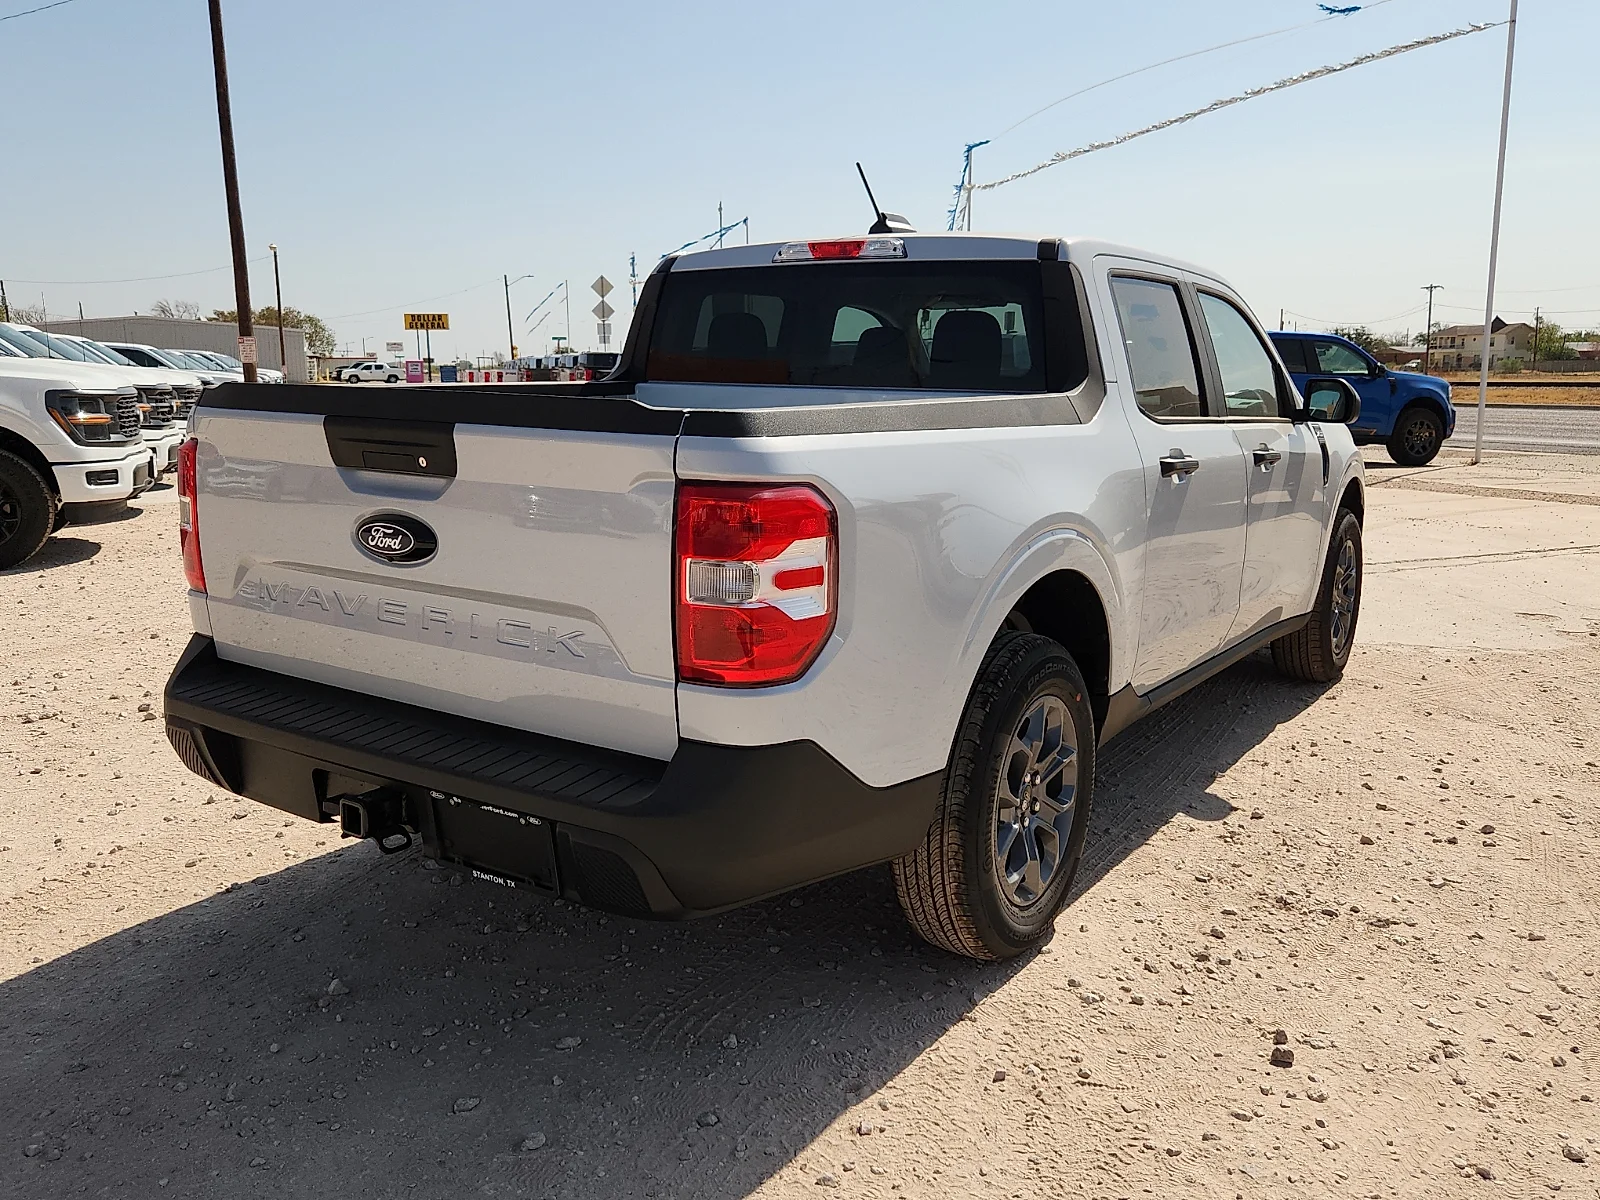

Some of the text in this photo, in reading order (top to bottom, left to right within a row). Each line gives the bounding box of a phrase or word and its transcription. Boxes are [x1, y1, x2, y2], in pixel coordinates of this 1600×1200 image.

[409, 322, 446, 330] GENERAL
[410, 314, 443, 322] DOLLAR
[368, 526, 403, 550] Ford
[260, 579, 587, 659] MAVERICK
[472, 870, 516, 888] STANTON, TX
